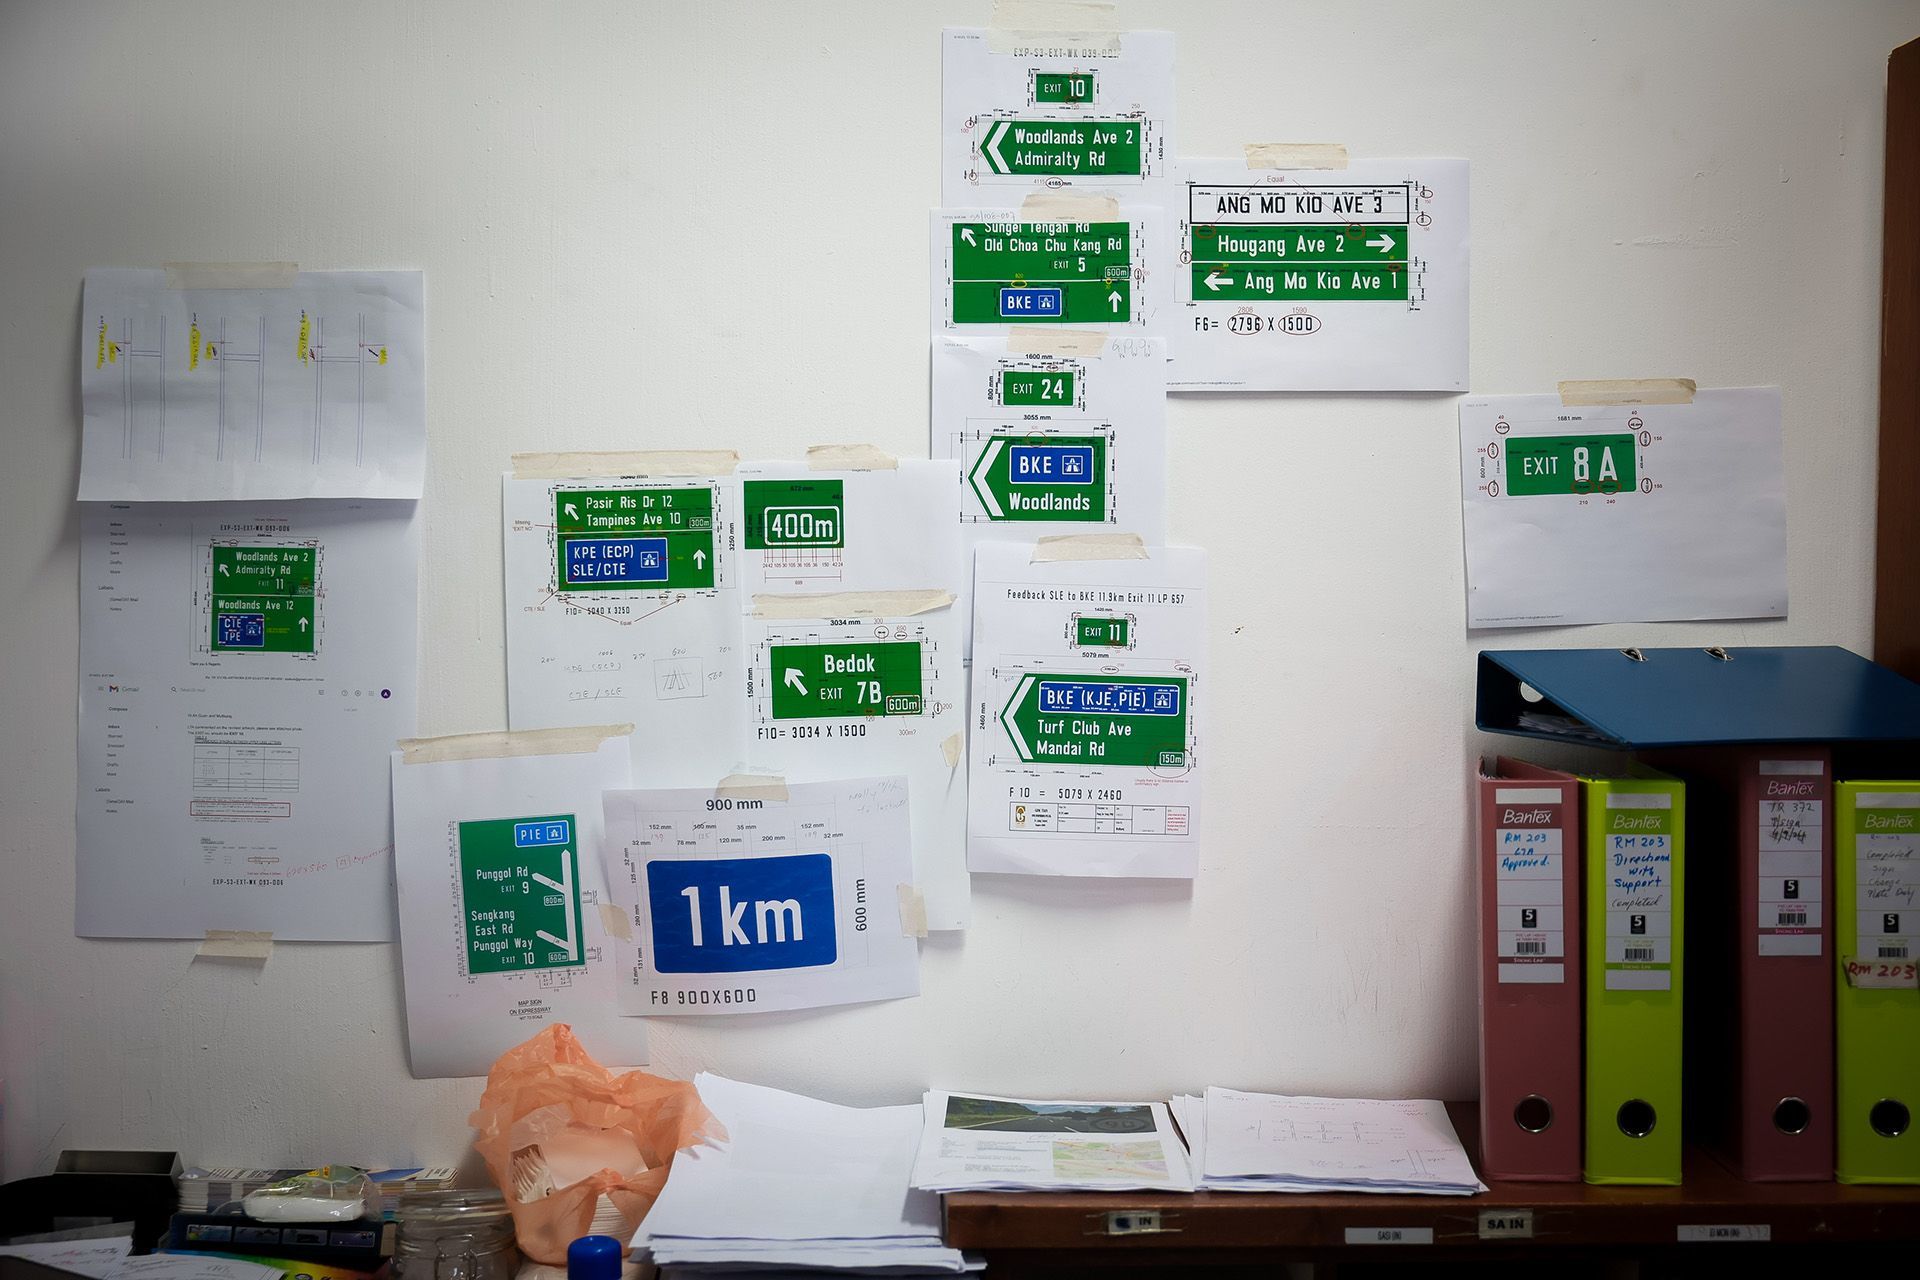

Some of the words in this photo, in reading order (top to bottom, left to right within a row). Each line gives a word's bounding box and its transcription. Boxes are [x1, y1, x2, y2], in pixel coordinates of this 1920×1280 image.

[1044, 84, 1061, 93] EXIT
[1069, 80, 1085, 97] 10
[1015, 129, 1084, 144] Woodlands
[1093, 130, 1117, 144] Ave
[1126, 130, 1133, 144] 2
[1015, 151, 1081, 169] Admiralty
[1089, 152, 1105, 166] Rd
[1217, 197, 1250, 214] ANG
[1261, 197, 1285, 213] MO
[1297, 196, 1322, 213] KIO
[1334, 196, 1363, 213] AVE
[1374, 197, 1382, 213] 3
[985, 240, 1002, 252] Old
[1010, 239, 1038, 252] Choa
[1045, 239, 1066, 251] Chu
[1074, 239, 1100, 254] Kang
[1108, 238, 1122, 250] Rd
[1218, 235, 1285, 257] Hougang
[1297, 236, 1325, 252] Ave
[1336, 235, 1344, 252] 2
[1054, 261, 1068, 269] EXIT
[1078, 258, 1085, 272] 5
[1245, 272, 1274, 293] Ang
[1285, 272, 1307, 289] Mo
[1317, 272, 1340, 289] Kio
[1352, 272, 1380, 289] Ave
[1391, 272, 1397, 288] 1
[1008, 296, 1031, 309] BKE
[1231, 317, 1261, 331] 2796
[1268, 317, 1274, 330] X
[1282, 317, 1313, 330] 1500
[1013, 384, 1033, 394] EXIT
[1042, 379, 1063, 399] 24
[1020, 456, 1052, 474] BKE
[1524, 456, 1558, 476] EXIT
[587, 496, 613, 509] Pasir
[621, 496, 636, 508] Ris
[643, 496, 655, 508] Dr
[663, 495, 672, 507] 12
[1009, 493, 1090, 511] Woodlands
[587, 513, 636, 528] Tampines
[643, 513, 662, 525] Ave
[670, 512, 681, 525] 10
[772, 513, 833, 538] 400m
[236, 552, 278, 562] Woodlands
[284, 553, 298, 562] Ave
[304, 553, 308, 562] 2
[574, 546, 596, 559] KPE
[602, 545, 634, 558] (ECP)
[236, 565, 276, 577] Admiralty
[281, 566, 291, 575] Rd
[276, 579, 284, 590] 11
[1008, 589, 1045, 600] Feedback
[1050, 591, 1063, 600] SLE
[1068, 592, 1076, 601] to
[1079, 591, 1094, 601] BKE
[1099, 592, 1125, 602] 11.9km
[1128, 593, 1144, 603] Exit
[1148, 594, 1154, 603] 11
[1158, 594, 1167, 603] LP
[218, 600, 260, 609] Woodlands
[266, 601, 280, 610] Ave
[286, 601, 293, 610] 12
[614, 606, 630, 614] 3250
[225, 632, 240, 641] TPE
[1085, 627, 1101, 636] EXIT
[1109, 624, 1120, 641] 11
[825, 654, 875, 674] Bedok
[821, 688, 843, 700] EXIT
[857, 681, 881, 704] 7B
[1047, 690, 1073, 705] BKE
[889, 699, 917, 710] 600m
[792, 726, 820, 739] 3034
[827, 726, 832, 737] X
[839, 725, 866, 736] 1500
[1038, 720, 1064, 734] Turf
[1072, 721, 1100, 735] Club
[1109, 722, 1132, 736] Ave
[1037, 741, 1081, 756] Mandai
[1089, 742, 1105, 756] Rd
[1161, 754, 1182, 764] 150m
[1010, 787, 1014, 798] F
[1059, 788, 1082, 799] 5079
[1087, 789, 1093, 800] X
[1098, 790, 1122, 801] 2460
[1767, 780, 1814, 796] Bantex
[706, 799, 733, 811] 900
[736, 799, 763, 809] mm
[1503, 809, 1551, 824] Bantex
[1613, 815, 1662, 829] Bantex
[1865, 814, 1914, 828] Bantex
[521, 828, 541, 840] PIE
[1526, 833, 1546, 843] 203
[1641, 836, 1664, 847] 203
[476, 868, 511, 881] Punggol
[517, 866, 528, 877] Rd
[501, 885, 515, 893] EXIT
[522, 881, 529, 894] 9
[855, 878, 865, 906] mm
[1787, 881, 1795, 891] 5
[472, 910, 515, 922] Sengkang
[855, 908, 867, 932] 600
[1525, 910, 1533, 920] 5
[1634, 916, 1642, 926] 5
[475, 924, 496, 936] East
[502, 924, 513, 934] Rd
[474, 939, 508, 952] Punggol
[514, 938, 533, 950] Way
[502, 956, 515, 964] EXIT
[523, 952, 535, 965] 10
[1878, 963, 1915, 980] 203
[652, 990, 669, 1005] F8
[678, 988, 756, 1005] 900X600
[1488, 1219, 1505, 1229] SA
[1510, 1219, 1524, 1229] IN
